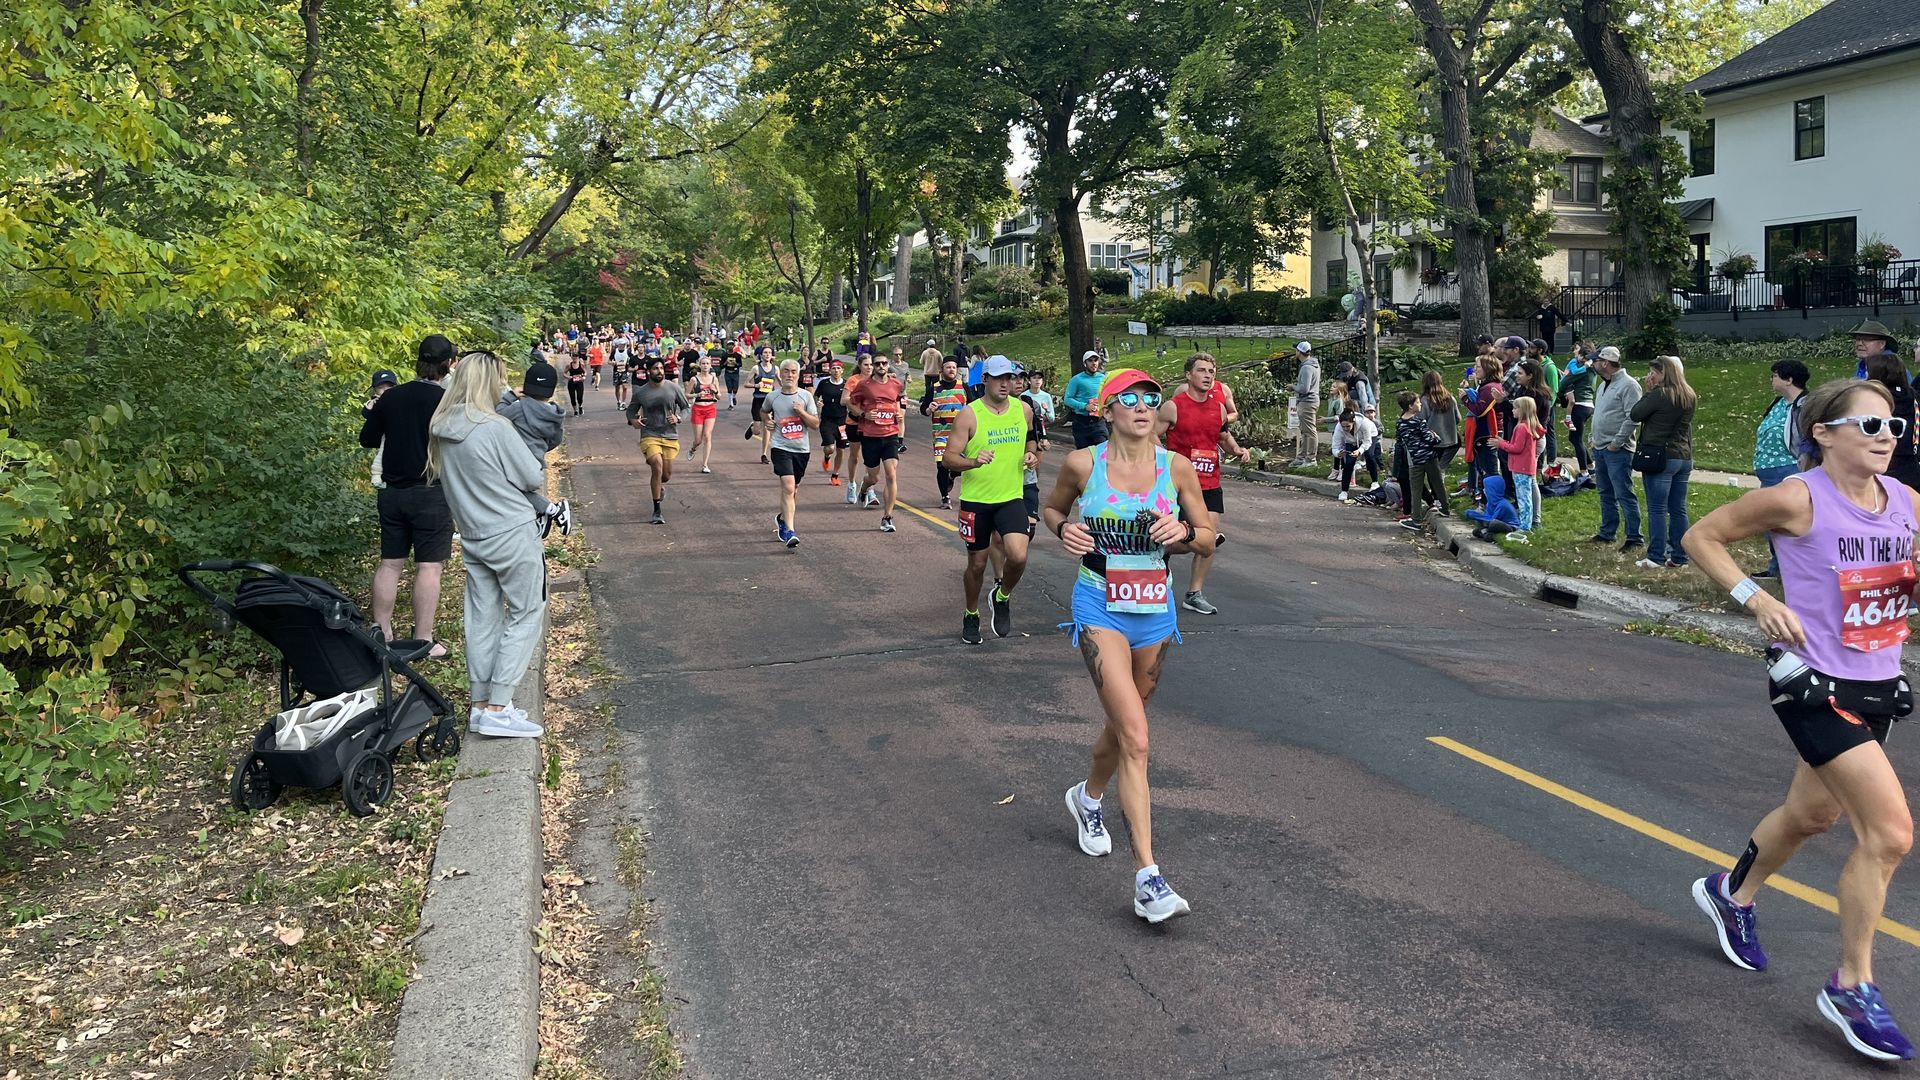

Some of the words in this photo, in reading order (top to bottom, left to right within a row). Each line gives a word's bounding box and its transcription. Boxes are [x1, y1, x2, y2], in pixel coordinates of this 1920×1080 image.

[876, 411, 894, 419] 4767
[781, 424, 803, 434] 6380
[988, 429, 1003, 437] MILL
[1004, 426, 1019, 435] CITY
[988, 435, 1020, 445] RUNNING
[1192, 461, 1215, 472] 5415
[1838, 536, 1864, 562] RUN
[1870, 536, 1891, 562] THE
[1895, 536, 1912, 561] RAC
[1109, 583, 1167, 599] 10149
[1860, 589, 1882, 598] PHIL
[1883, 585, 1900, 595] 4:13
[1843, 594, 1909, 627] 4642
